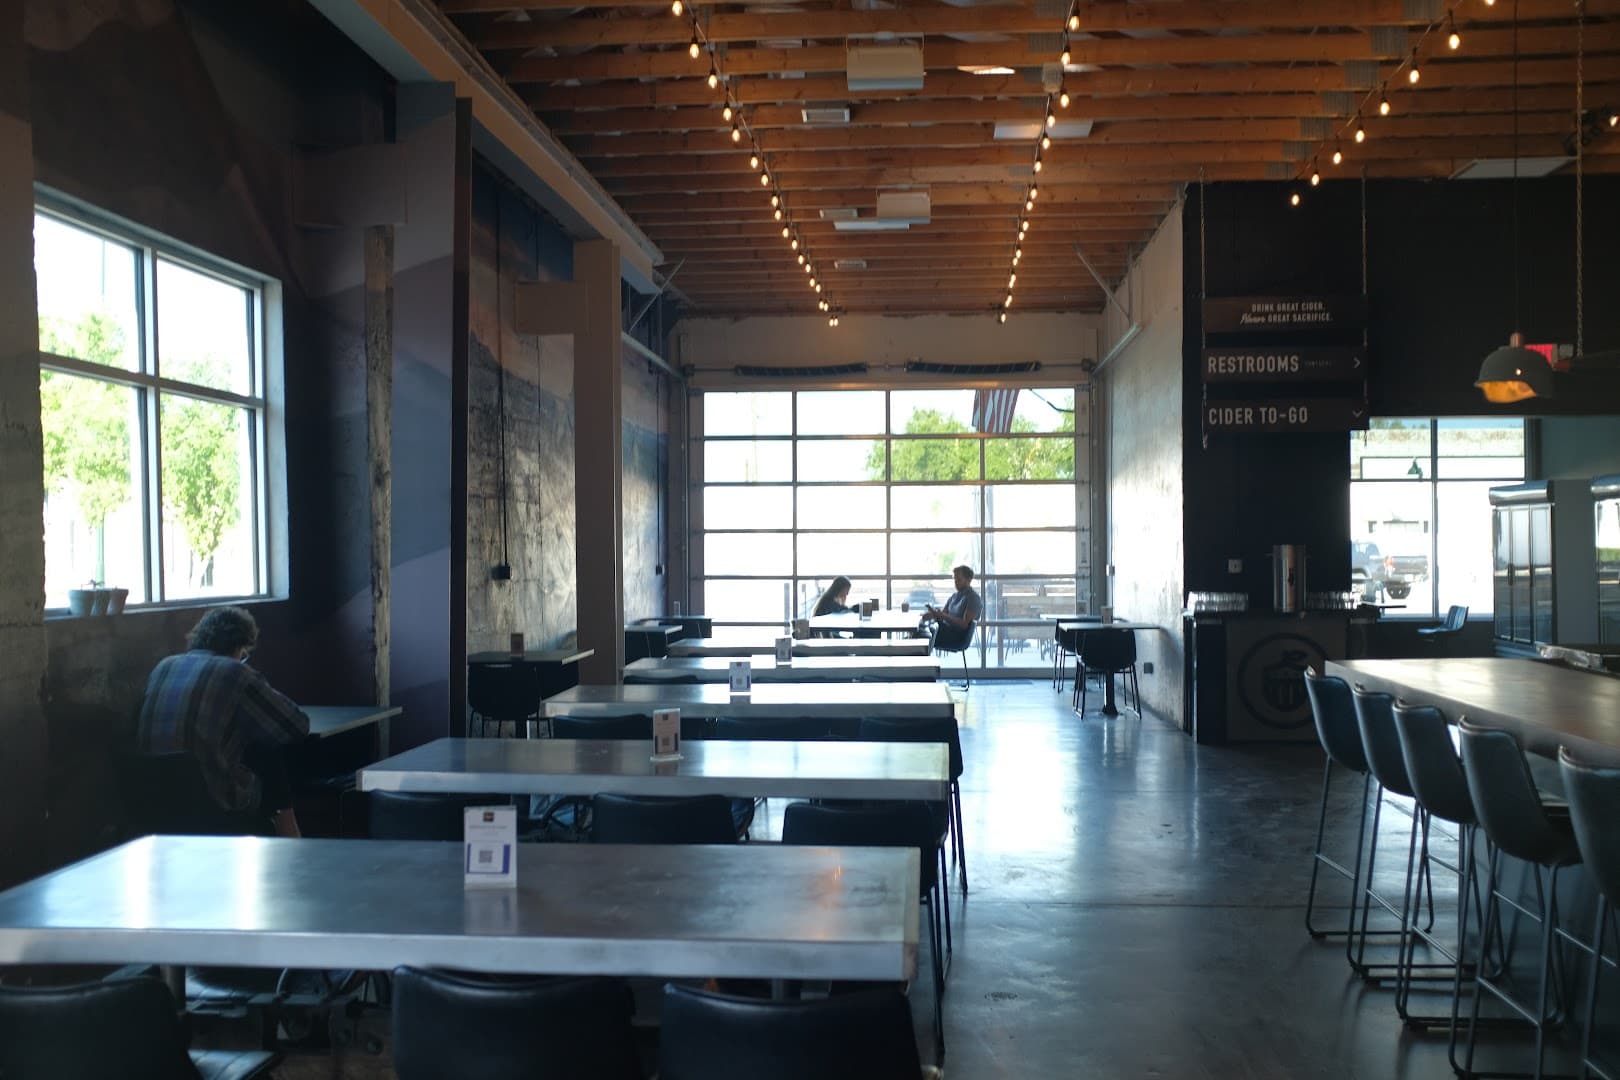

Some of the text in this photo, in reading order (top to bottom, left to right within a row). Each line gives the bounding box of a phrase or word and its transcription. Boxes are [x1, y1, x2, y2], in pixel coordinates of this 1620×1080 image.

[1252, 303, 1274, 312] DRINK
[1277, 302, 1299, 312] GREAT
[1268, 313, 1290, 322] GREAT
[1208, 355, 1299, 373] RESTROOMS
[1208, 406, 1308, 425] CIDER TO-GO
